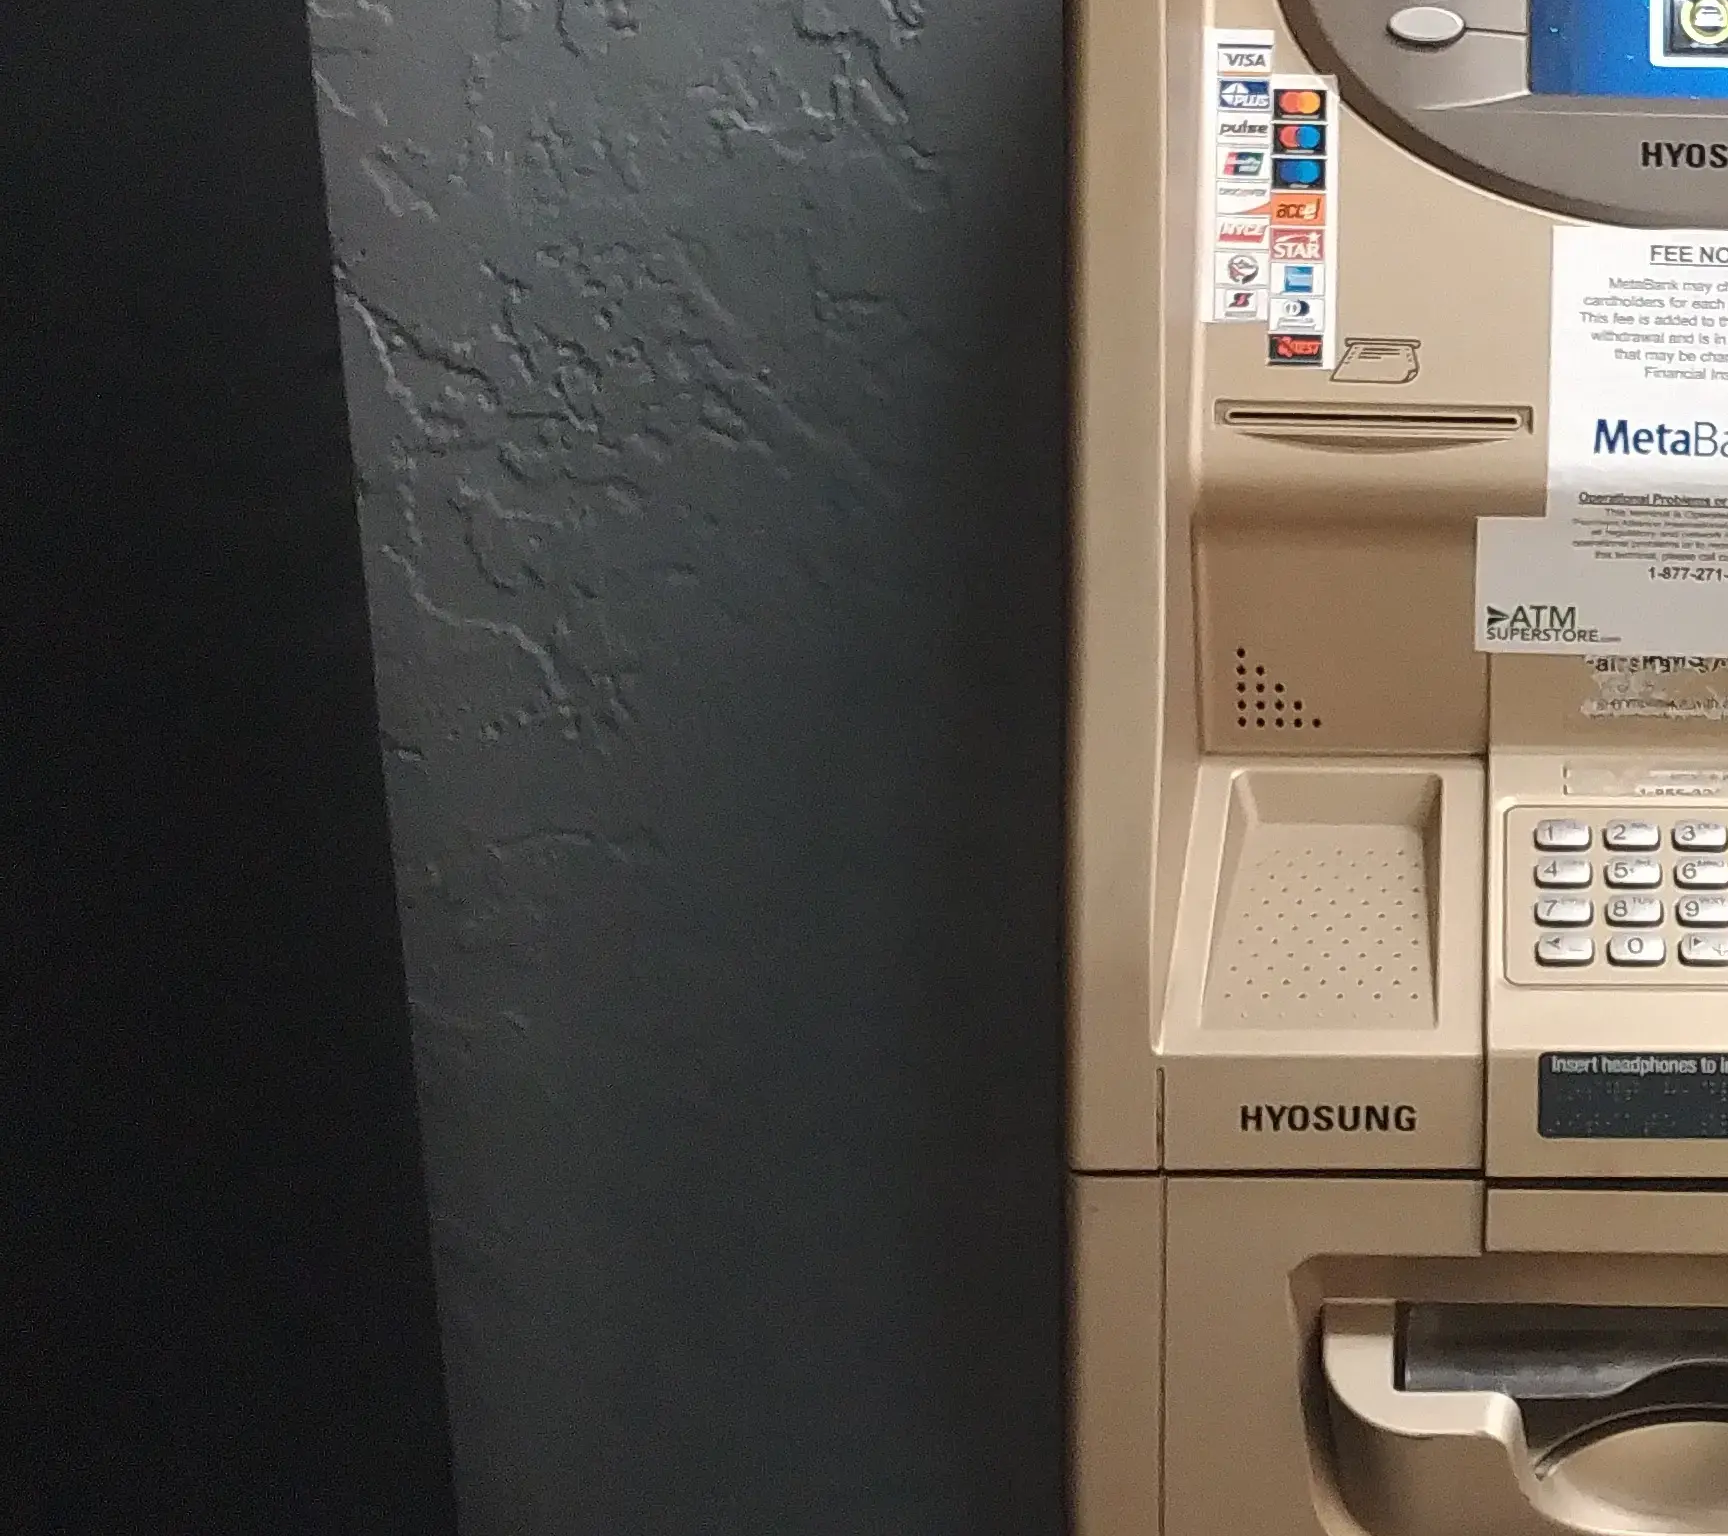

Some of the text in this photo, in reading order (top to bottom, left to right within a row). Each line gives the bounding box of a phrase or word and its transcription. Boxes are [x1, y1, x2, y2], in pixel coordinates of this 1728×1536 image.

[1224, 52, 1267, 68] VISA
[1219, 118, 1269, 136] pulse
[1272, 241, 1321, 259] STAR
[1650, 244, 1693, 263] FEE
[1579, 311, 1609, 324] This
[1613, 312, 1635, 325] fee
[1701, 316, 1716, 327] to
[1678, 350, 1697, 362] be
[1509, 604, 1577, 629] ATM
[1485, 626, 1600, 643] SUPERSTORE
[1612, 824, 1626, 841] 2
[1680, 825, 1696, 842] 3
[1543, 860, 1558, 877] 4
[1613, 861, 1628, 879] 5
[1681, 862, 1697, 880] 6
[1544, 899, 1558, 917] 7
[1612, 899, 1628, 917] 8
[1684, 900, 1700, 917] 9
[1551, 1054, 1598, 1074] Insert
[1601, 1055, 1698, 1077] headphones
[1700, 1057, 1718, 1074] to
[1239, 1104, 1418, 1132] HYOSUNG
